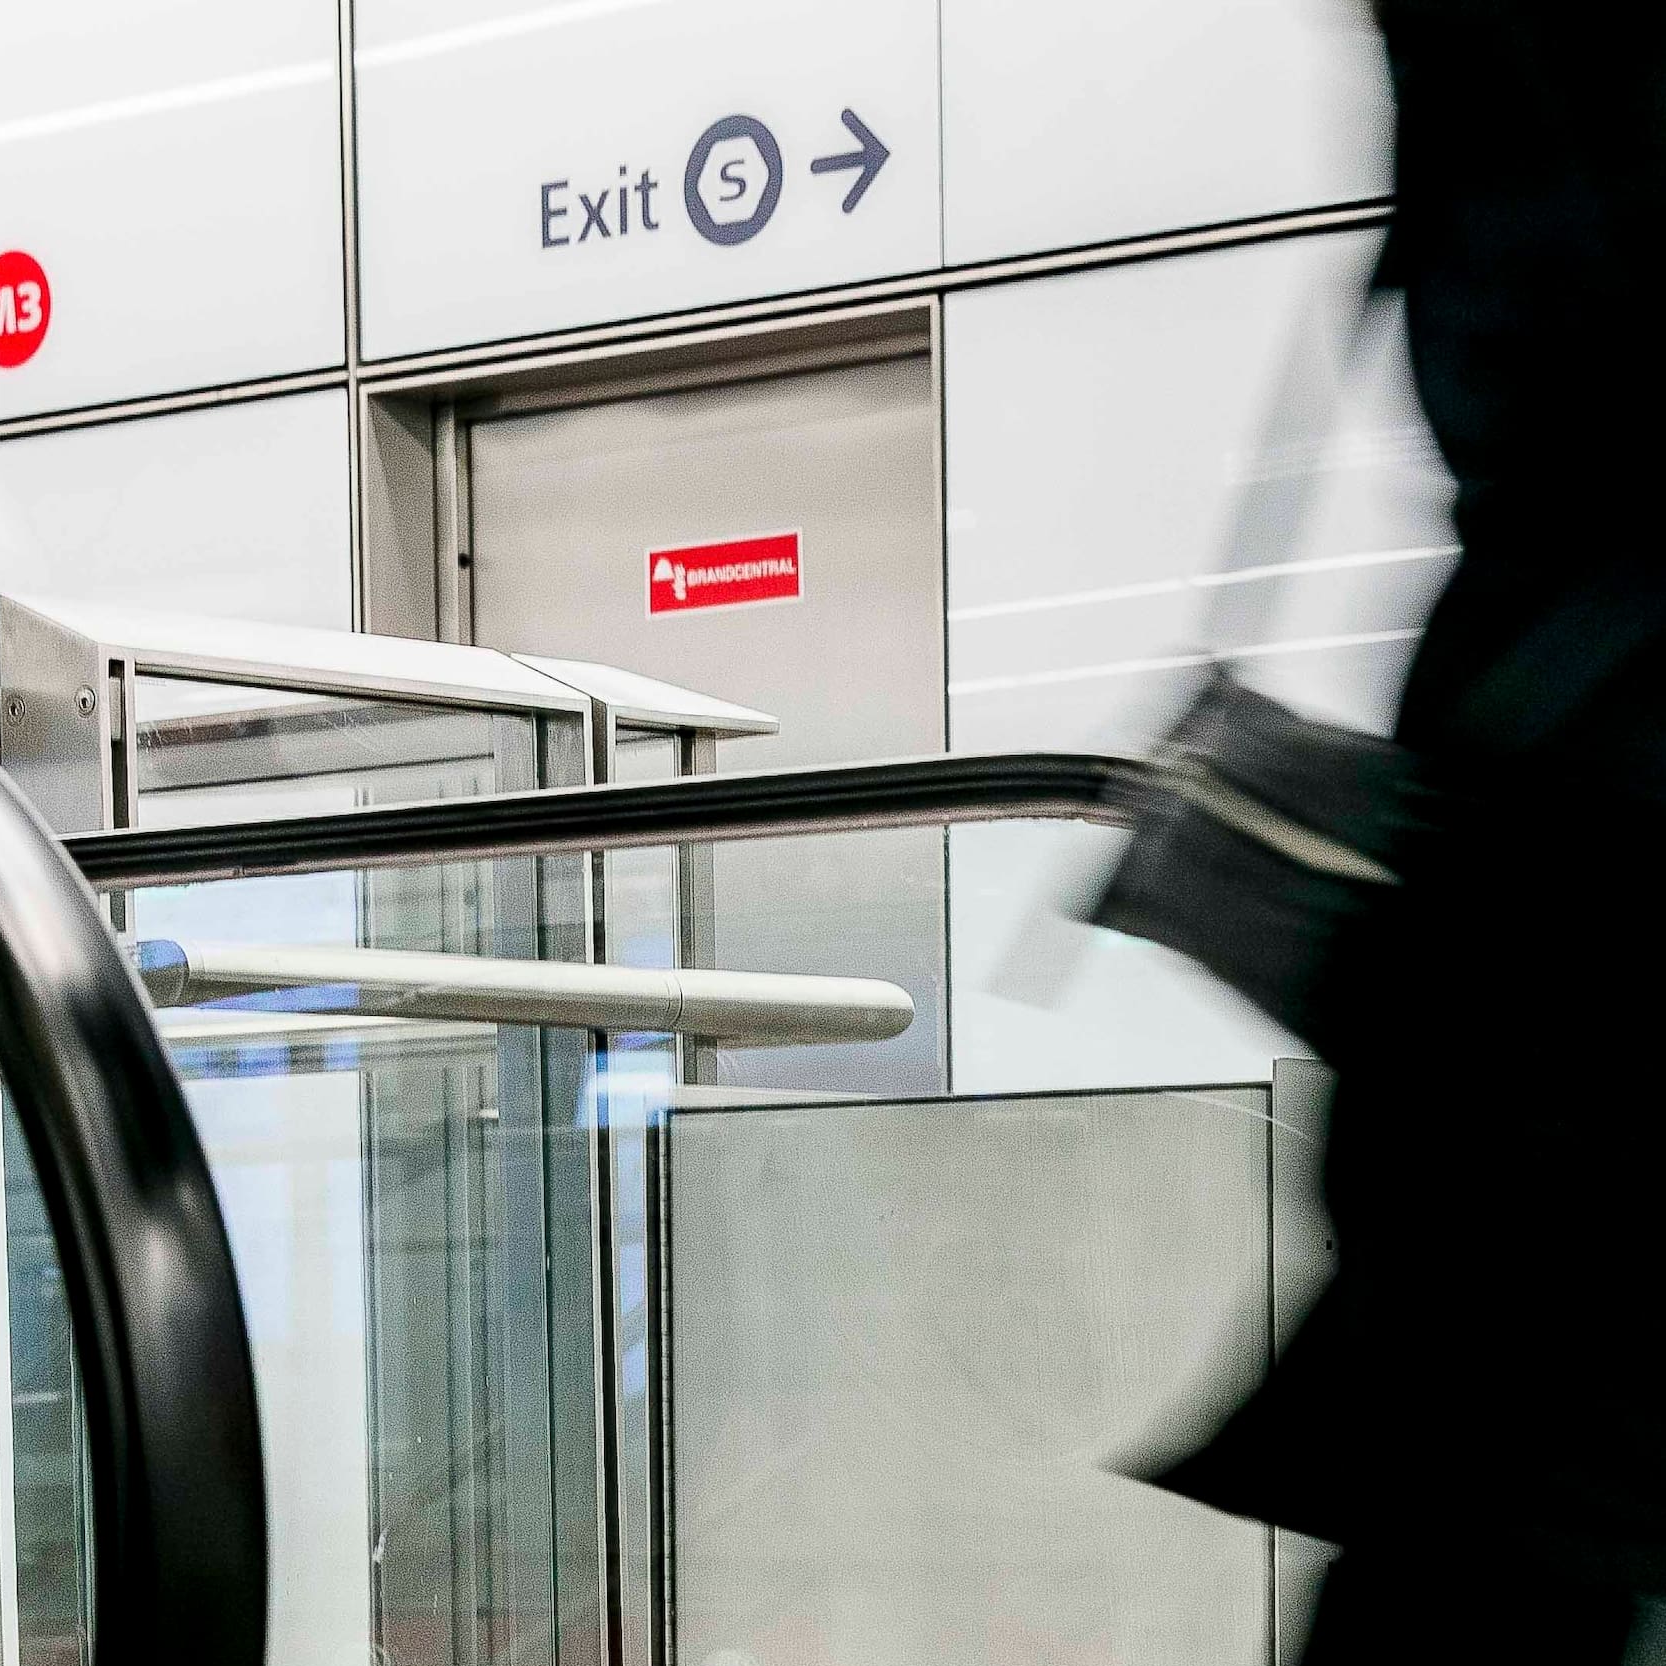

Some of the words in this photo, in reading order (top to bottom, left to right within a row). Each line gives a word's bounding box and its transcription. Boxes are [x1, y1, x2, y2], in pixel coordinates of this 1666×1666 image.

[540, 163, 659, 249] Exit
[718, 157, 747, 202] S
[686, 557, 797, 588] BRANDCENTRAL
